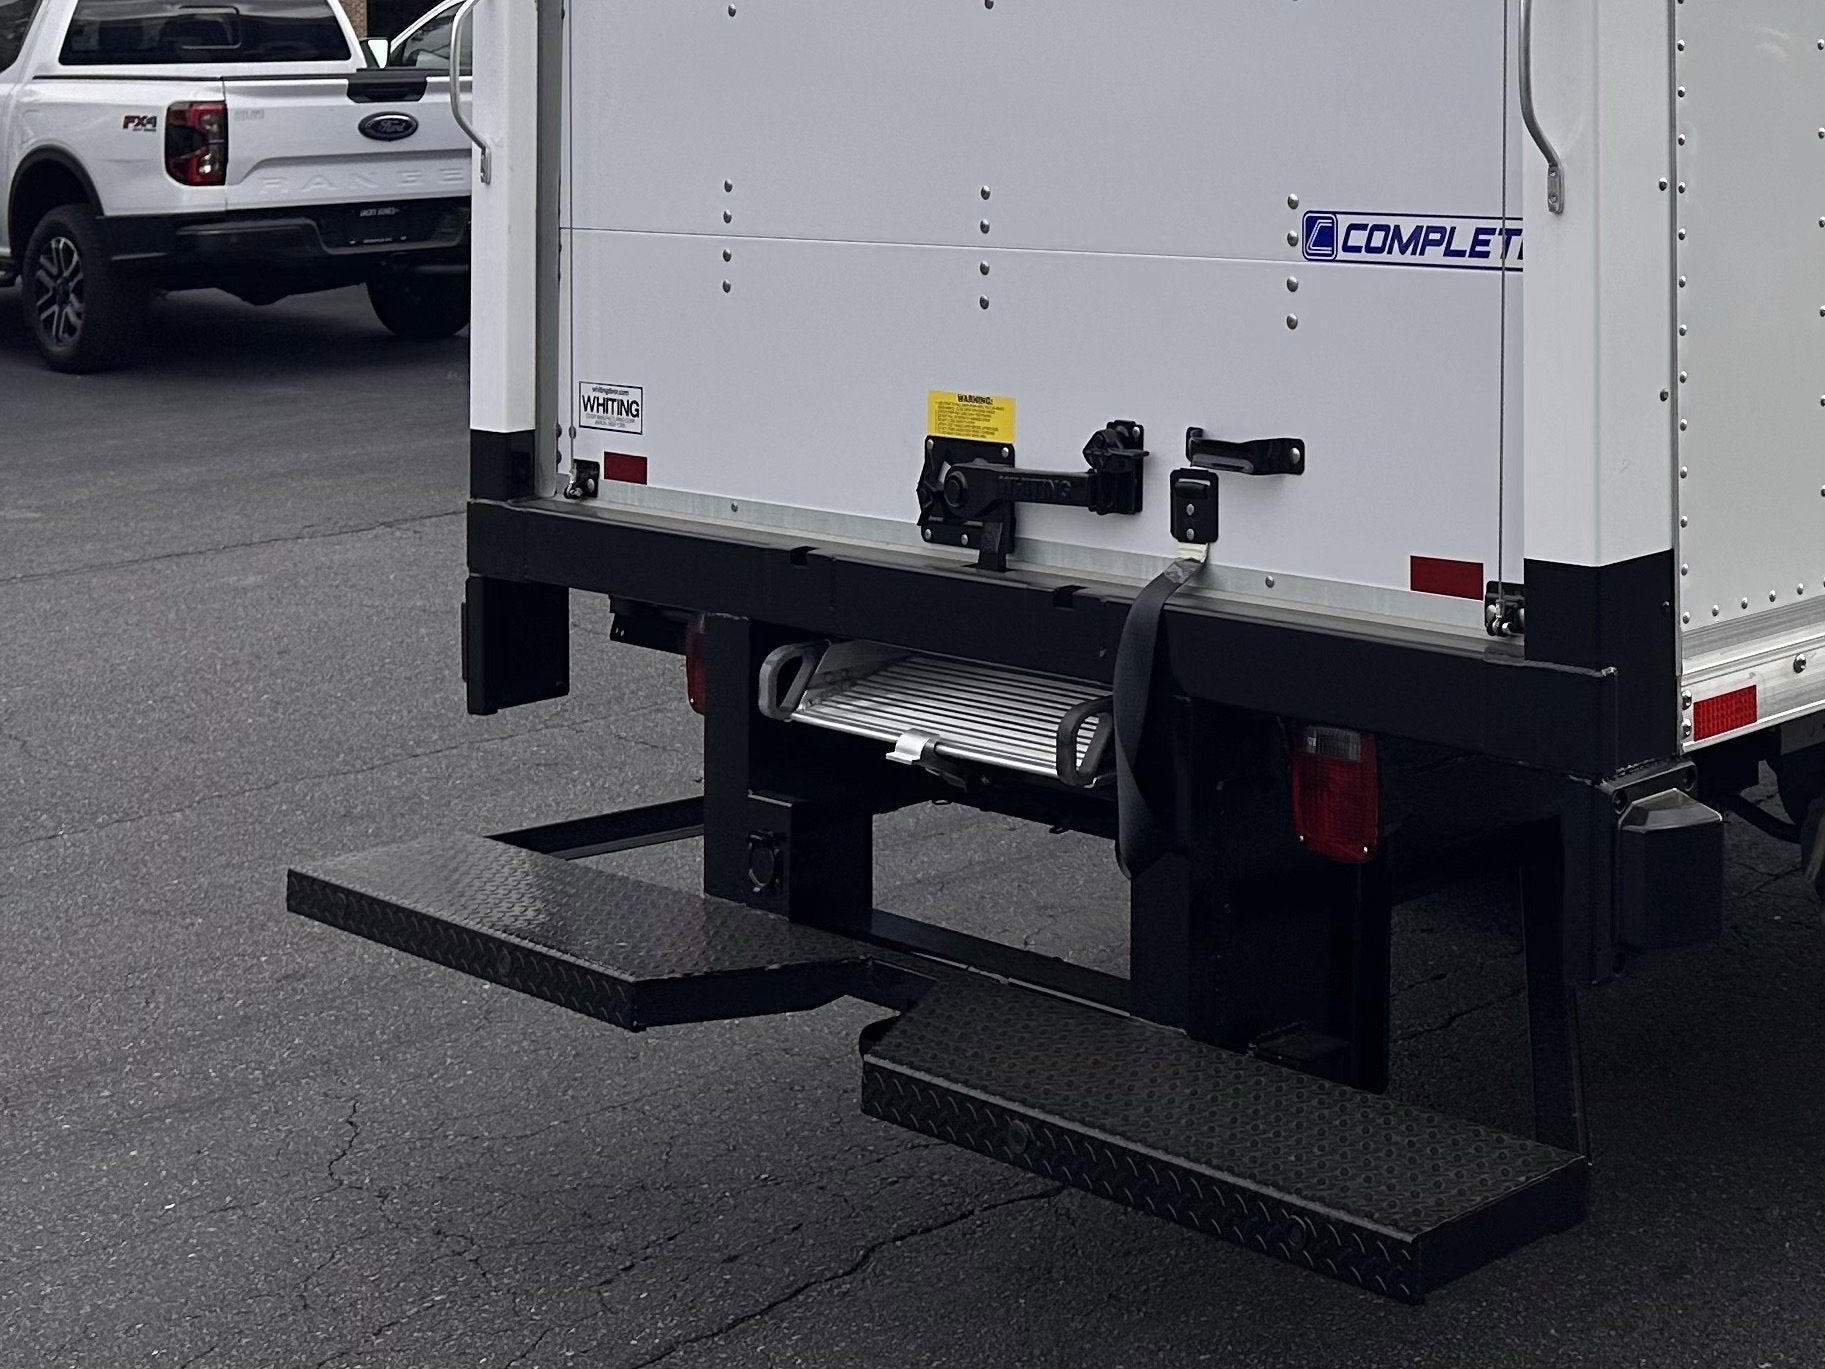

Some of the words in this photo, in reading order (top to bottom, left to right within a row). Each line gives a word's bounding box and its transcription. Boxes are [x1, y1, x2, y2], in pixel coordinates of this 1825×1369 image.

[122, 115, 158, 130] FX4
[378, 120, 406, 133] Ford
[581, 394, 640, 419] WHITING
